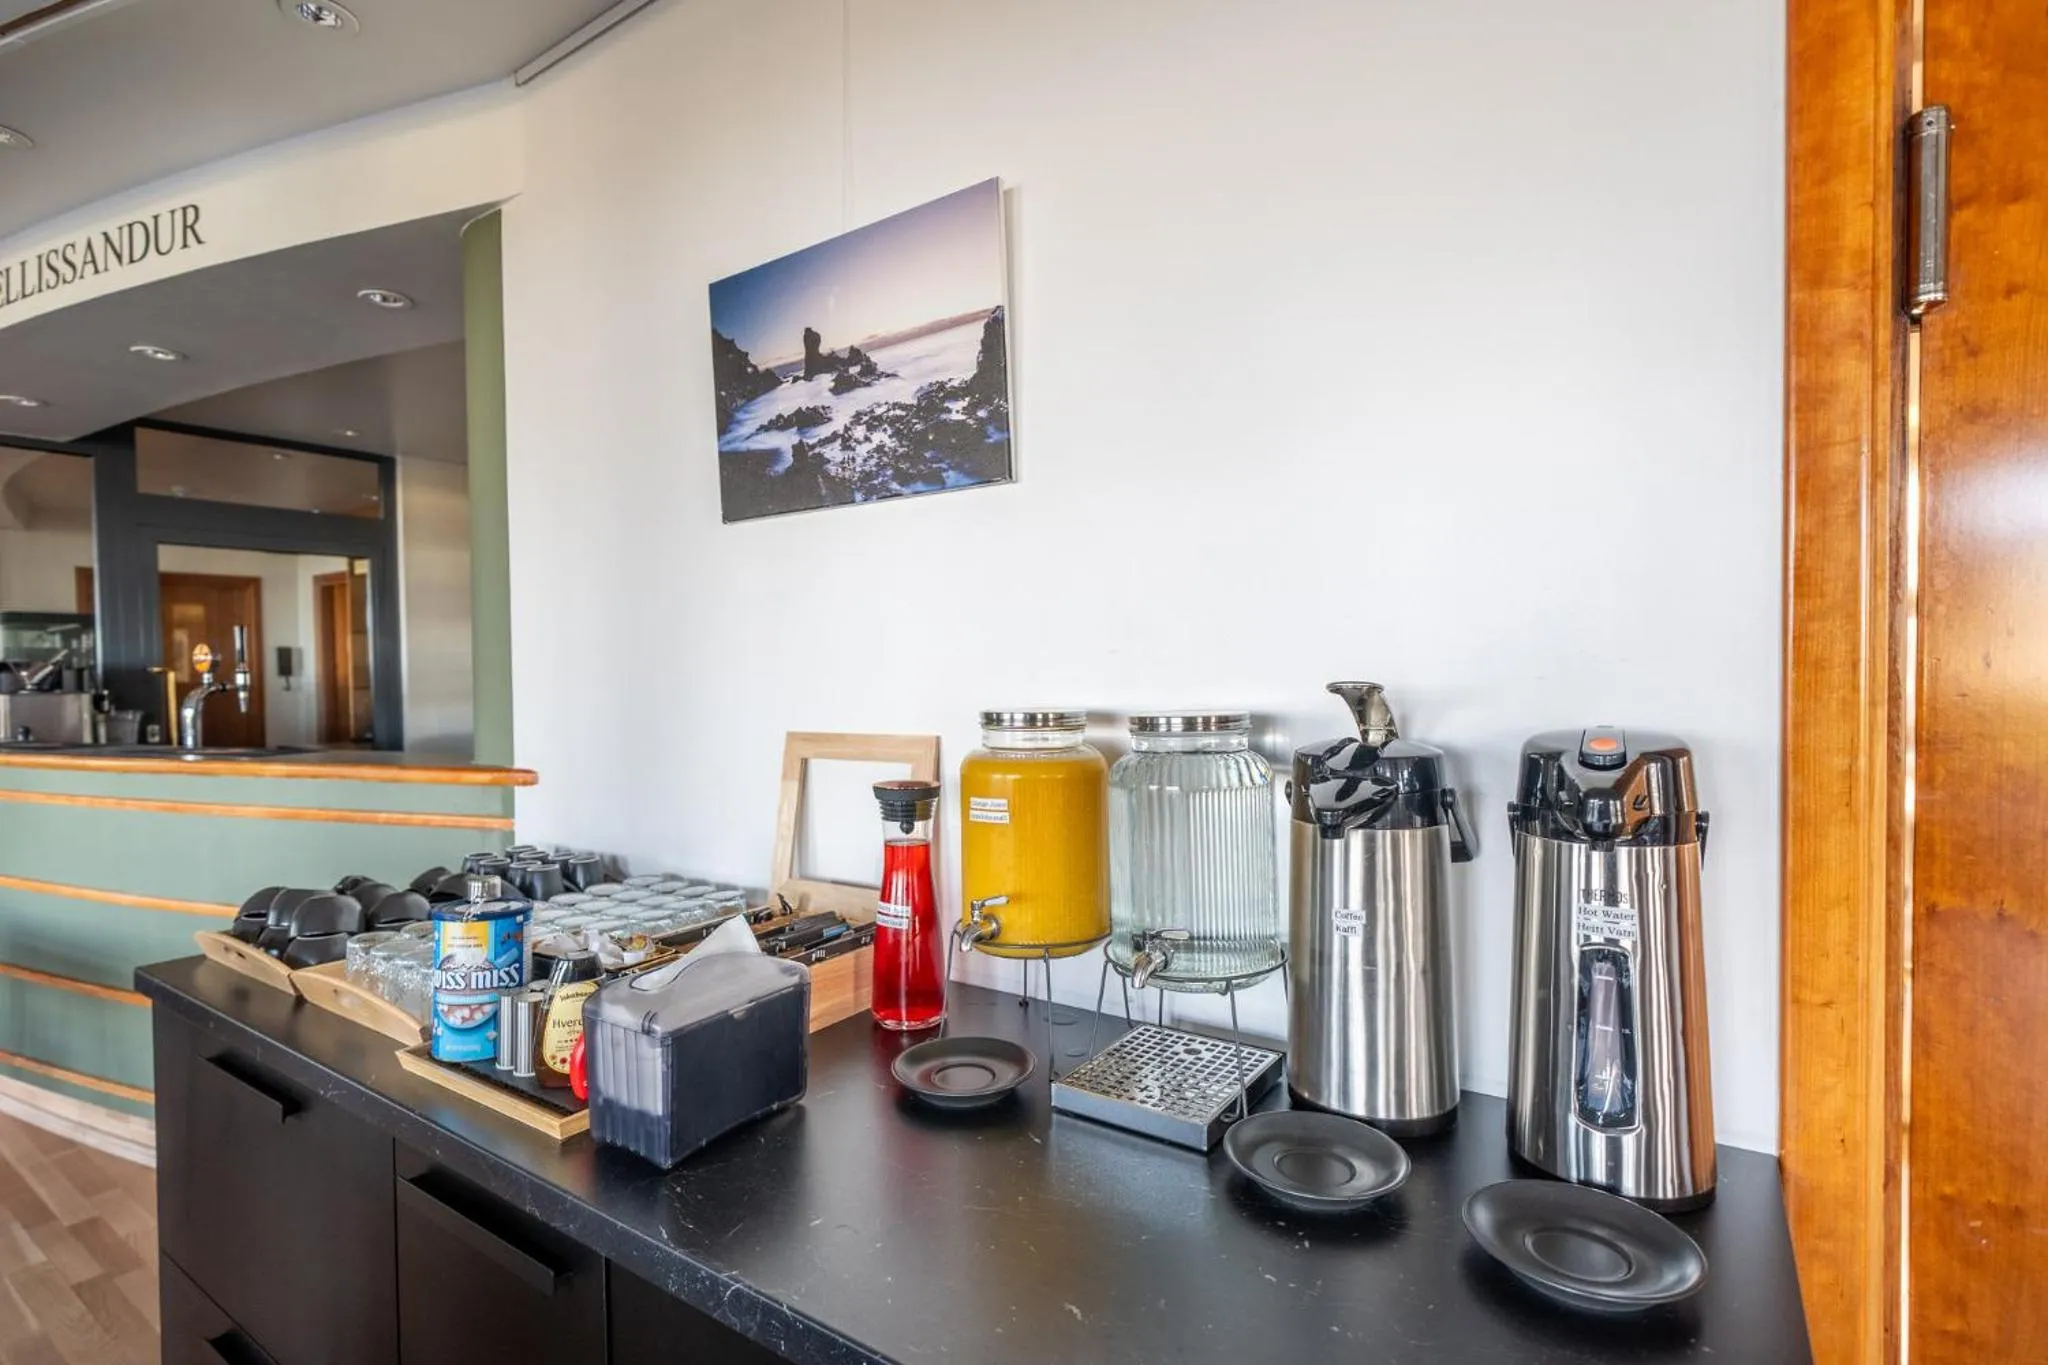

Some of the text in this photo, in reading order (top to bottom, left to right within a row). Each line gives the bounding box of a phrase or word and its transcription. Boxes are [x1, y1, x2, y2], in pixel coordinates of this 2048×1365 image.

[1334, 910, 1364, 920] Coffee
[1578, 906, 1635, 921] Hot Water
[1336, 924, 1357, 934] Kaffi
